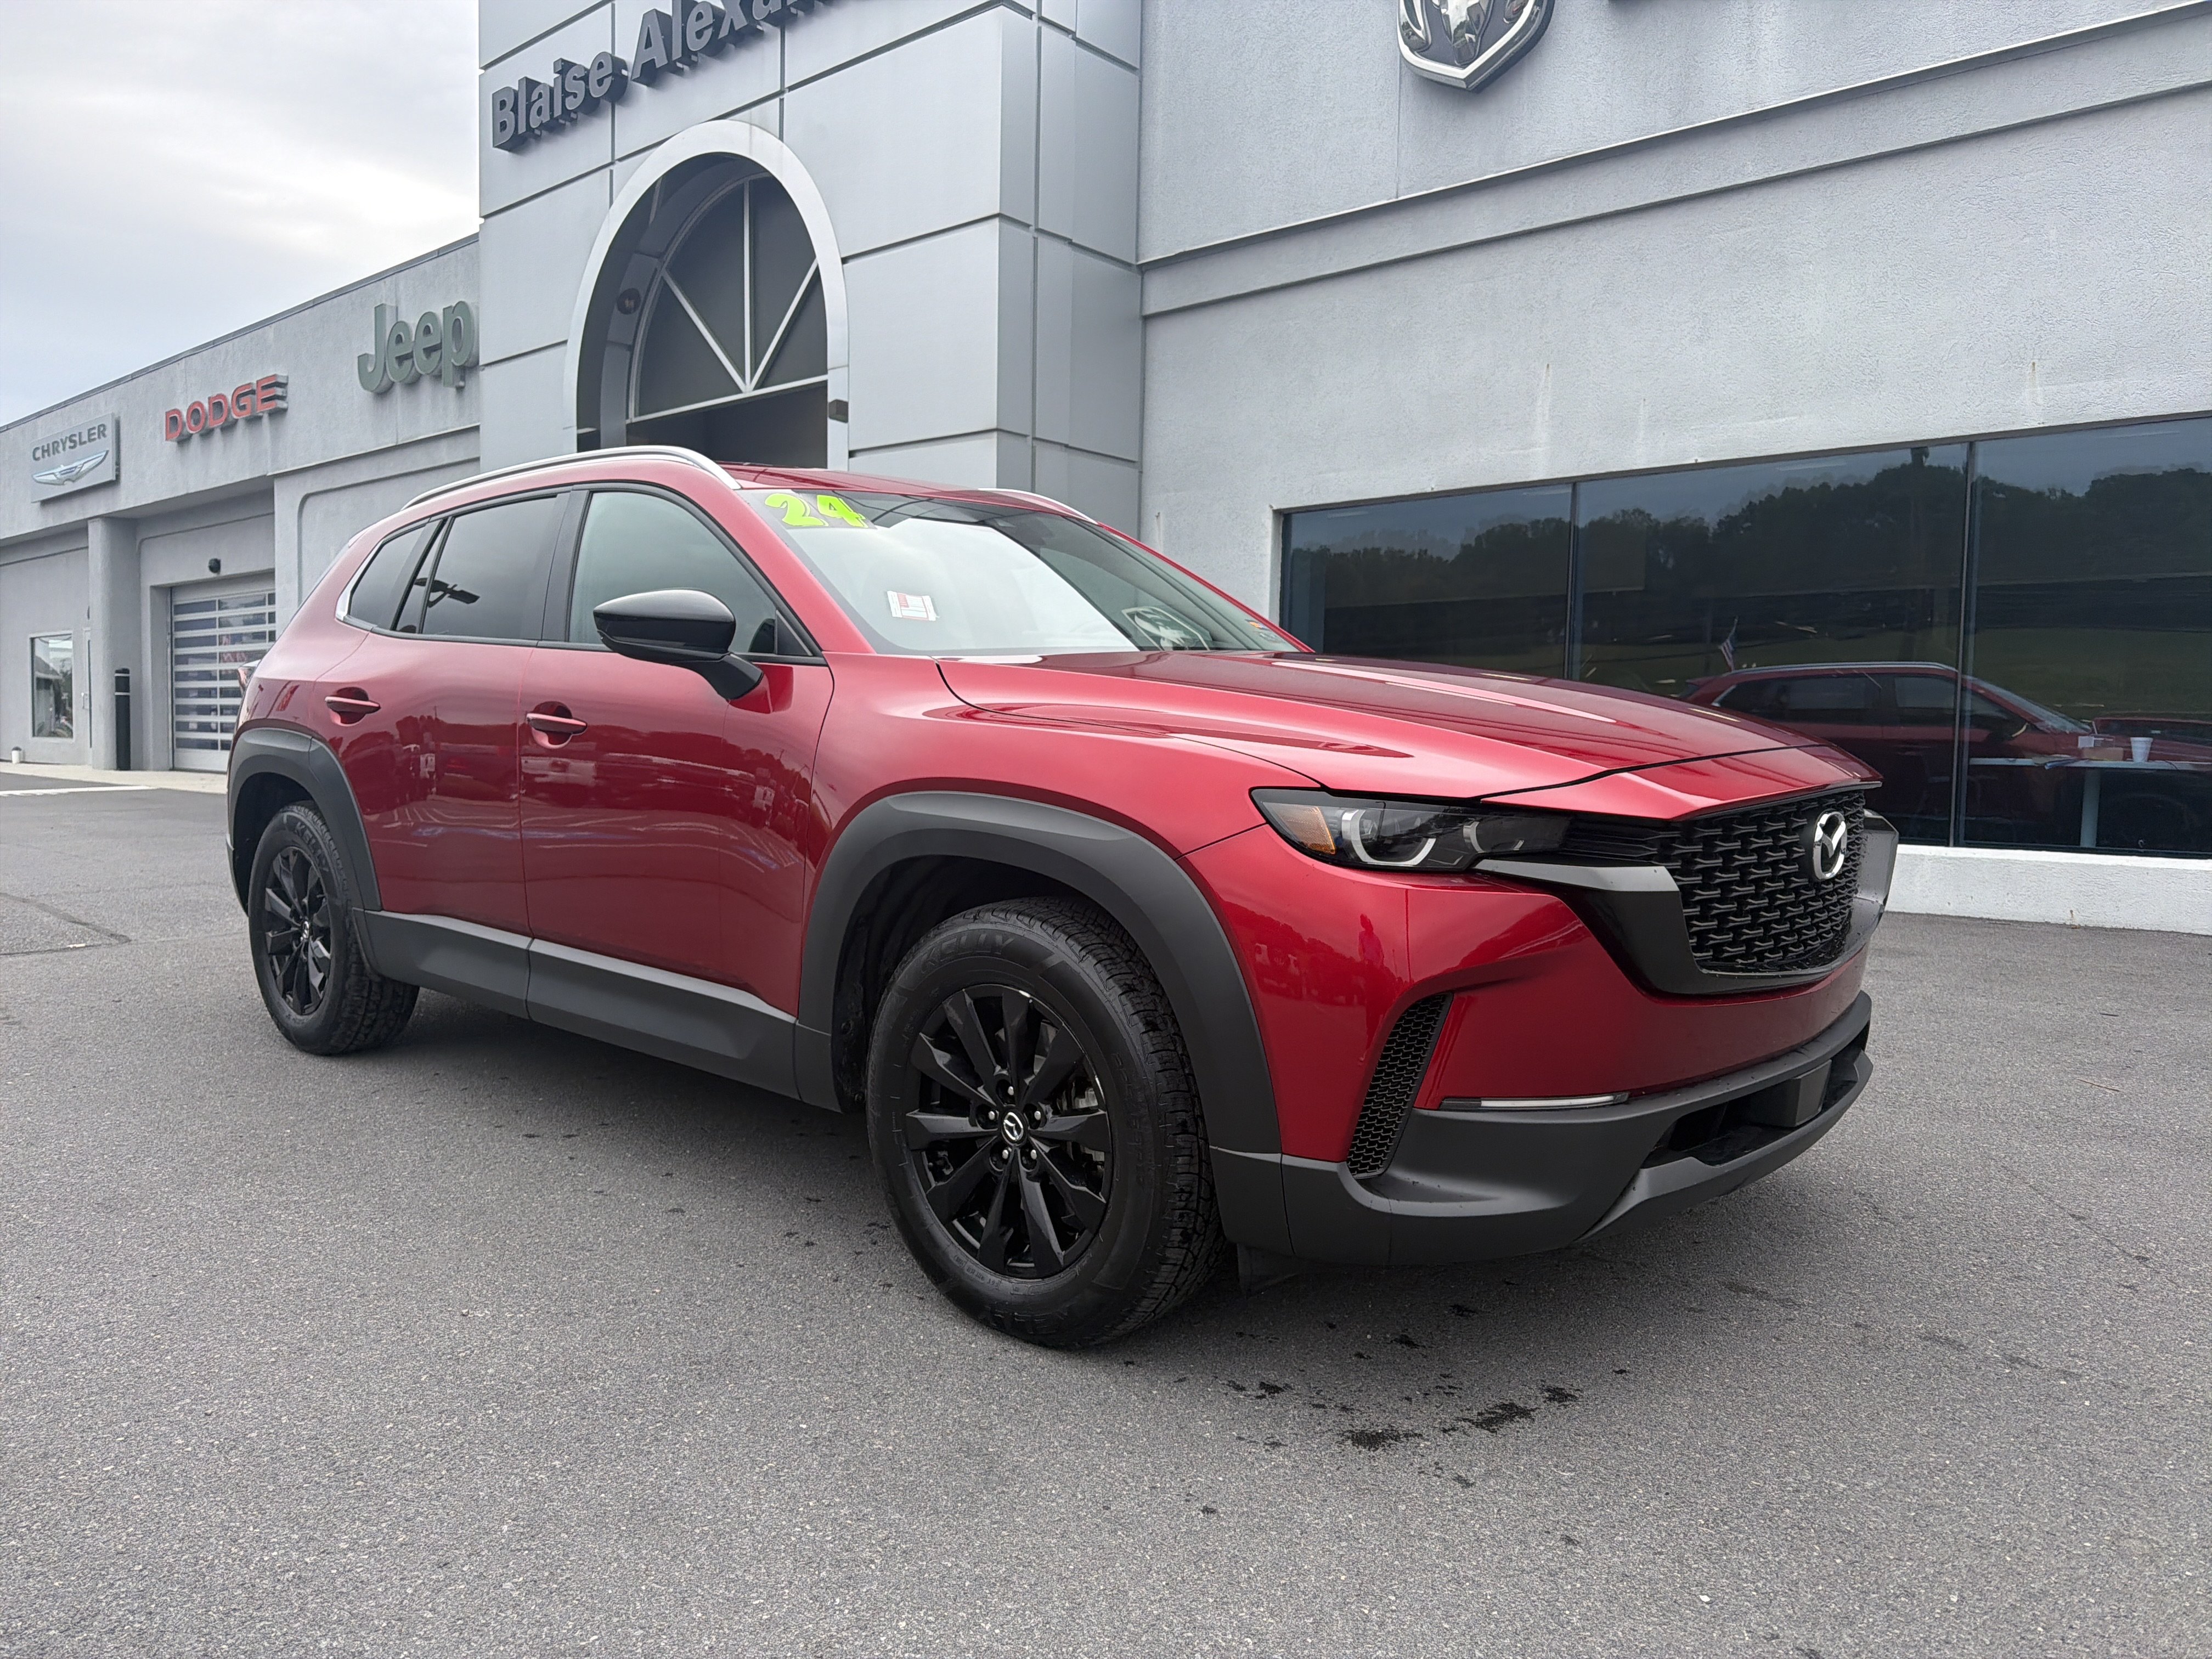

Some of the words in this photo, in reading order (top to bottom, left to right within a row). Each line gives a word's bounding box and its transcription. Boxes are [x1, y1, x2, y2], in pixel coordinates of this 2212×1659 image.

[492, 51, 613, 148] Blaise
[630, 0, 795, 81] Alex
[357, 300, 475, 392] Jeep
[165, 374, 280, 441] DODGE
[32, 423, 107, 461] CHRYSLER
[764, 493, 868, 528] 24
